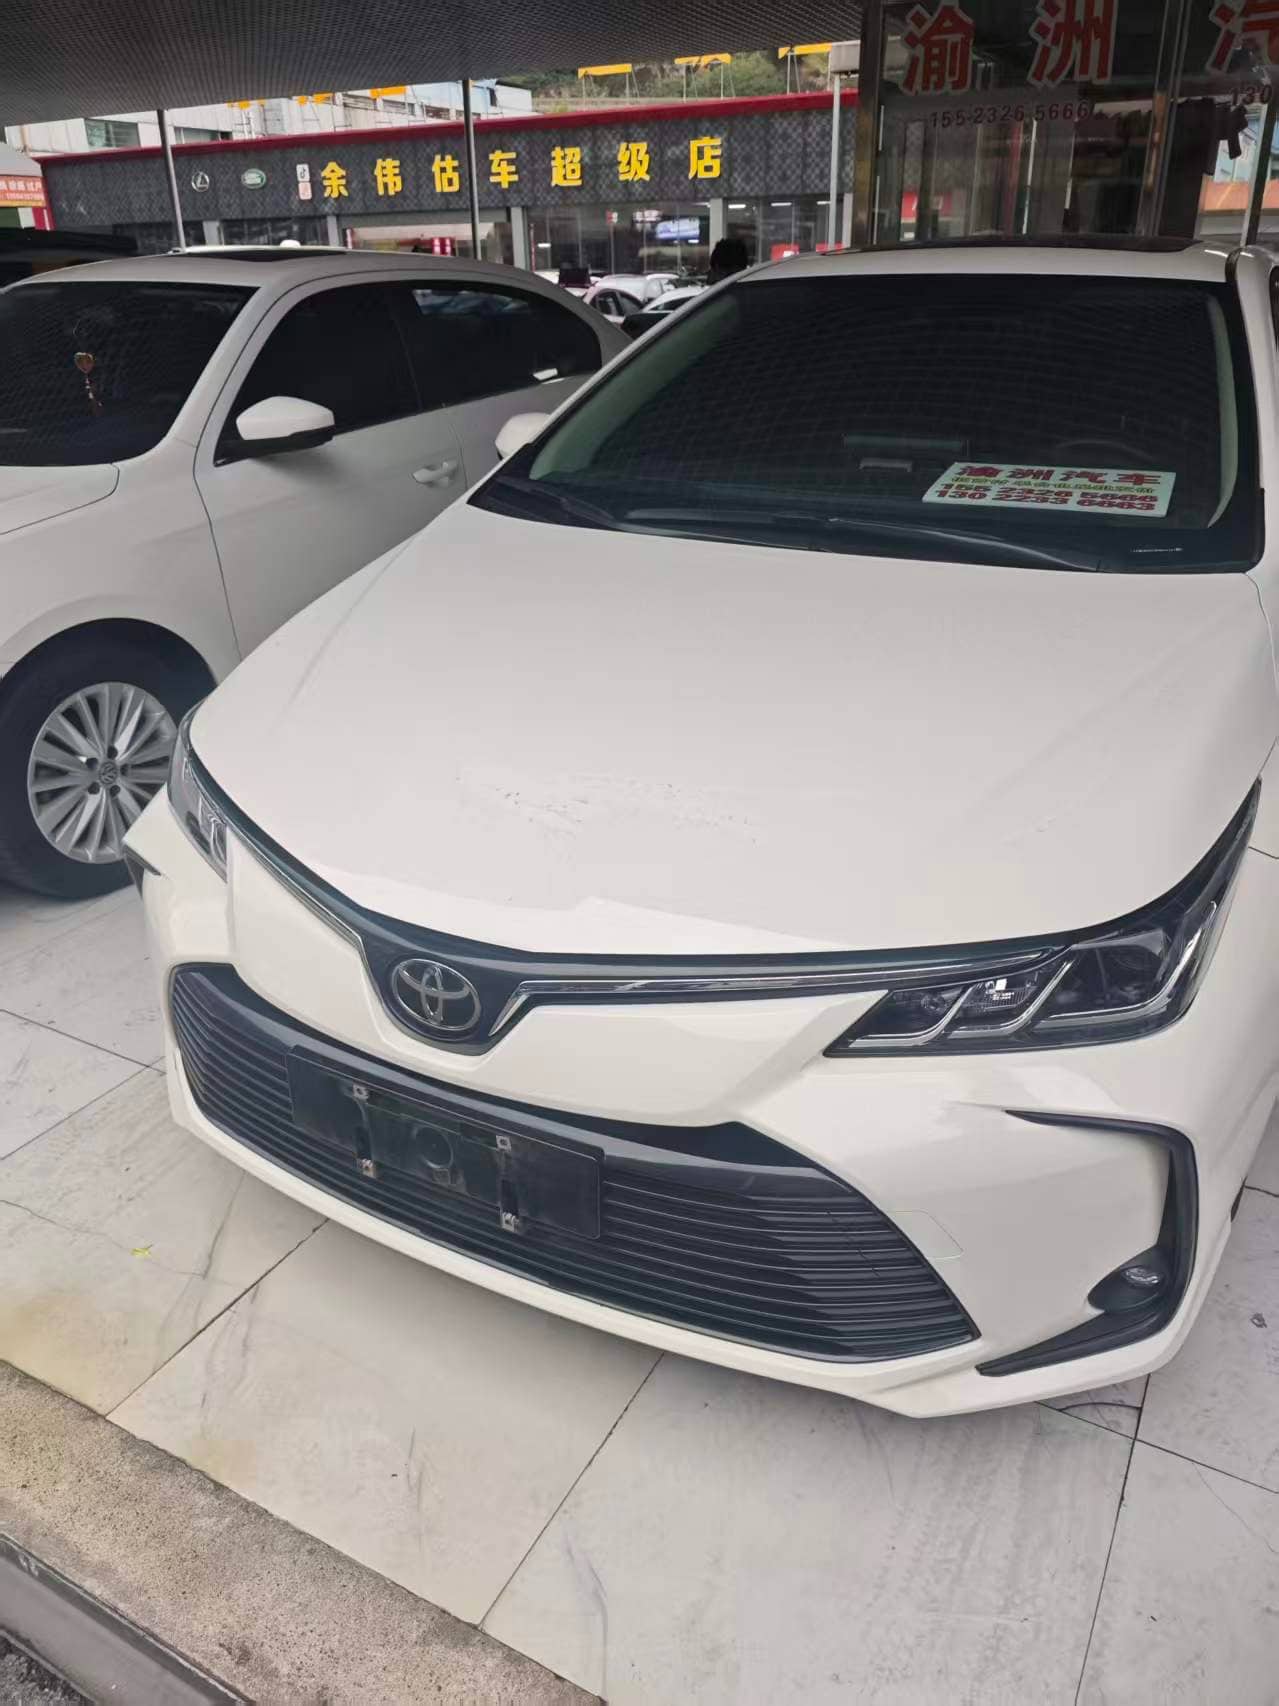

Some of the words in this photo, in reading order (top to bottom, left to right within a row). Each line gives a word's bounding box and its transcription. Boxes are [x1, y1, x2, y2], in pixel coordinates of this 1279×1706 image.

[321, 136, 723, 199] 余伟估车超级店
[935, 490, 988, 499] 130
[995, 486, 1073, 497] 2326
